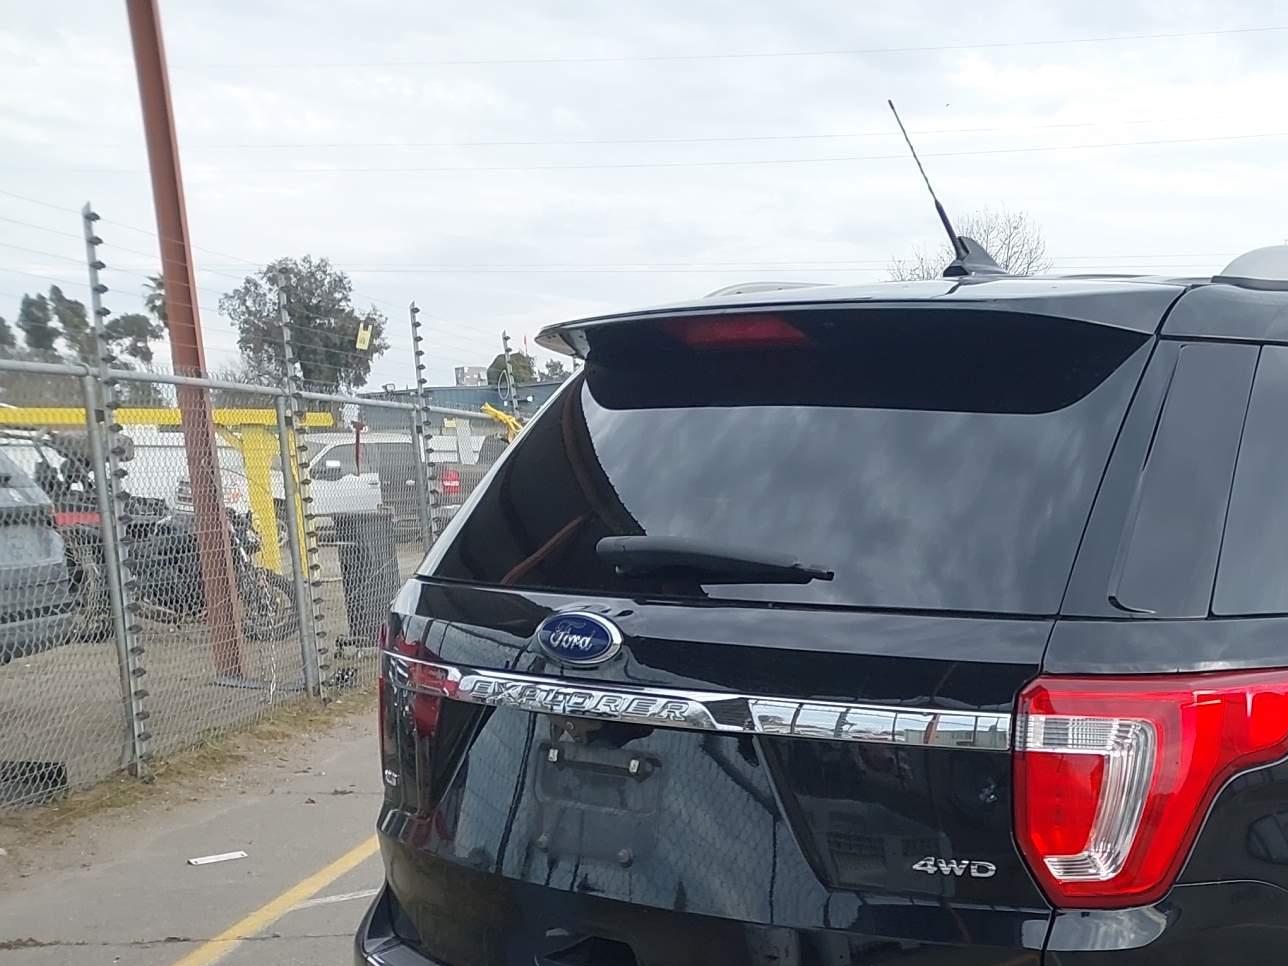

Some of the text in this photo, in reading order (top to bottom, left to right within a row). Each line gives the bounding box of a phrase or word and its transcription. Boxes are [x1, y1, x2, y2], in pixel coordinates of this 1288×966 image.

[550, 619, 595, 651] Ford
[471, 680, 689, 721] EXPLORER
[912, 856, 997, 878] 4WD
